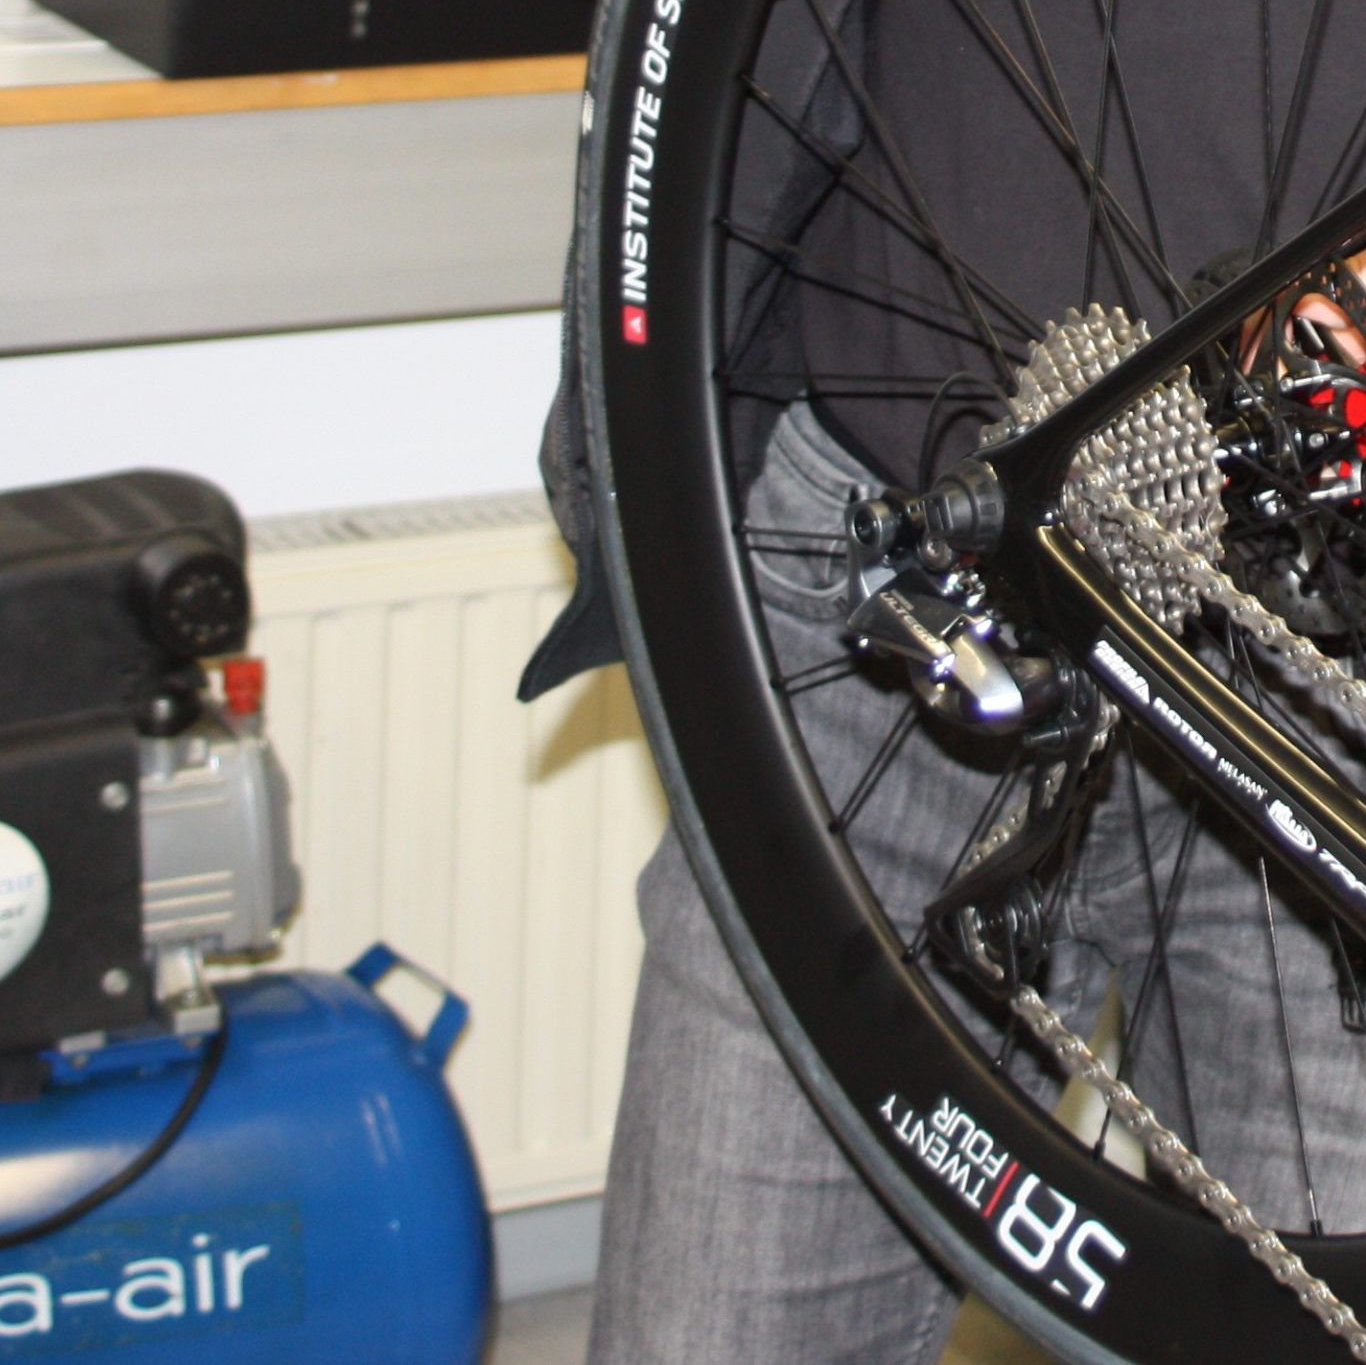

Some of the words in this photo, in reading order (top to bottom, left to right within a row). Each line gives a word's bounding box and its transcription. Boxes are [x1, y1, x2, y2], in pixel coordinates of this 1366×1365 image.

[641, 22, 672, 86] OF
[622, 86, 662, 303] INSTITUTE
[1153, 697, 1218, 760] ROTOR
[878, 1094, 986, 1209] TWENTY
[931, 1096, 1009, 1179] FOUR
[997, 1173, 1127, 1311] 58
